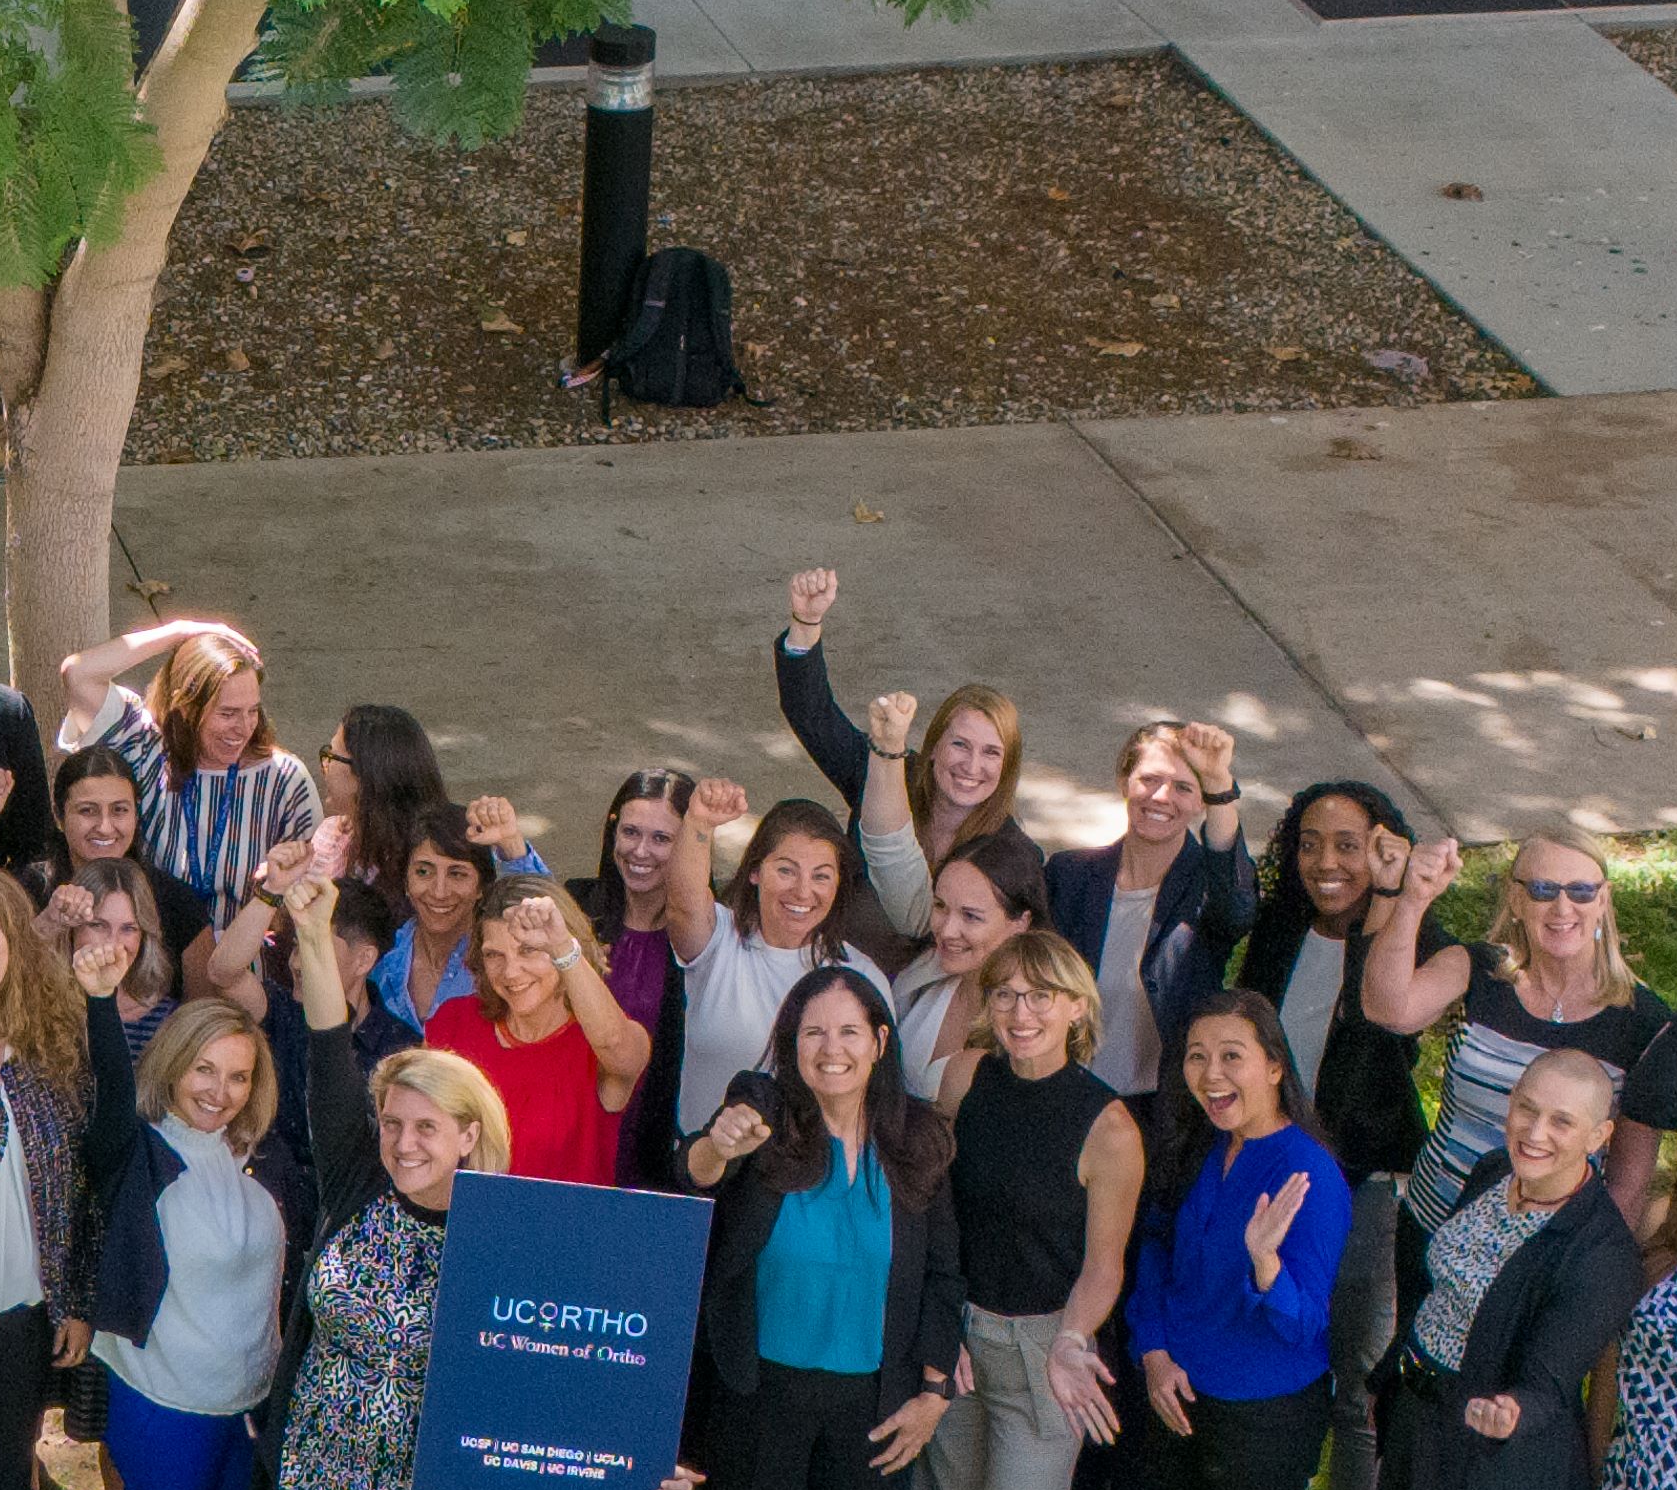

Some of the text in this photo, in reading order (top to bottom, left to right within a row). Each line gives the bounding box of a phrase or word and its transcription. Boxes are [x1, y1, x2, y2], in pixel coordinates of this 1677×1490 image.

[493, 1295, 648, 1338] UCORTHO
[478, 1331, 647, 1367] UC Women of Ortho
[460, 1435, 492, 1450] UCSF
[501, 1441, 520, 1454] UC
[521, 1443, 545, 1456] SAN
[547, 1446, 584, 1462] DIEGO
[593, 1453, 626, 1468] UCLA
[483, 1454, 501, 1467] UC
[503, 1457, 538, 1472] DAVIS
[547, 1462, 566, 1475] UC
[567, 1464, 606, 1480] IRVINE
